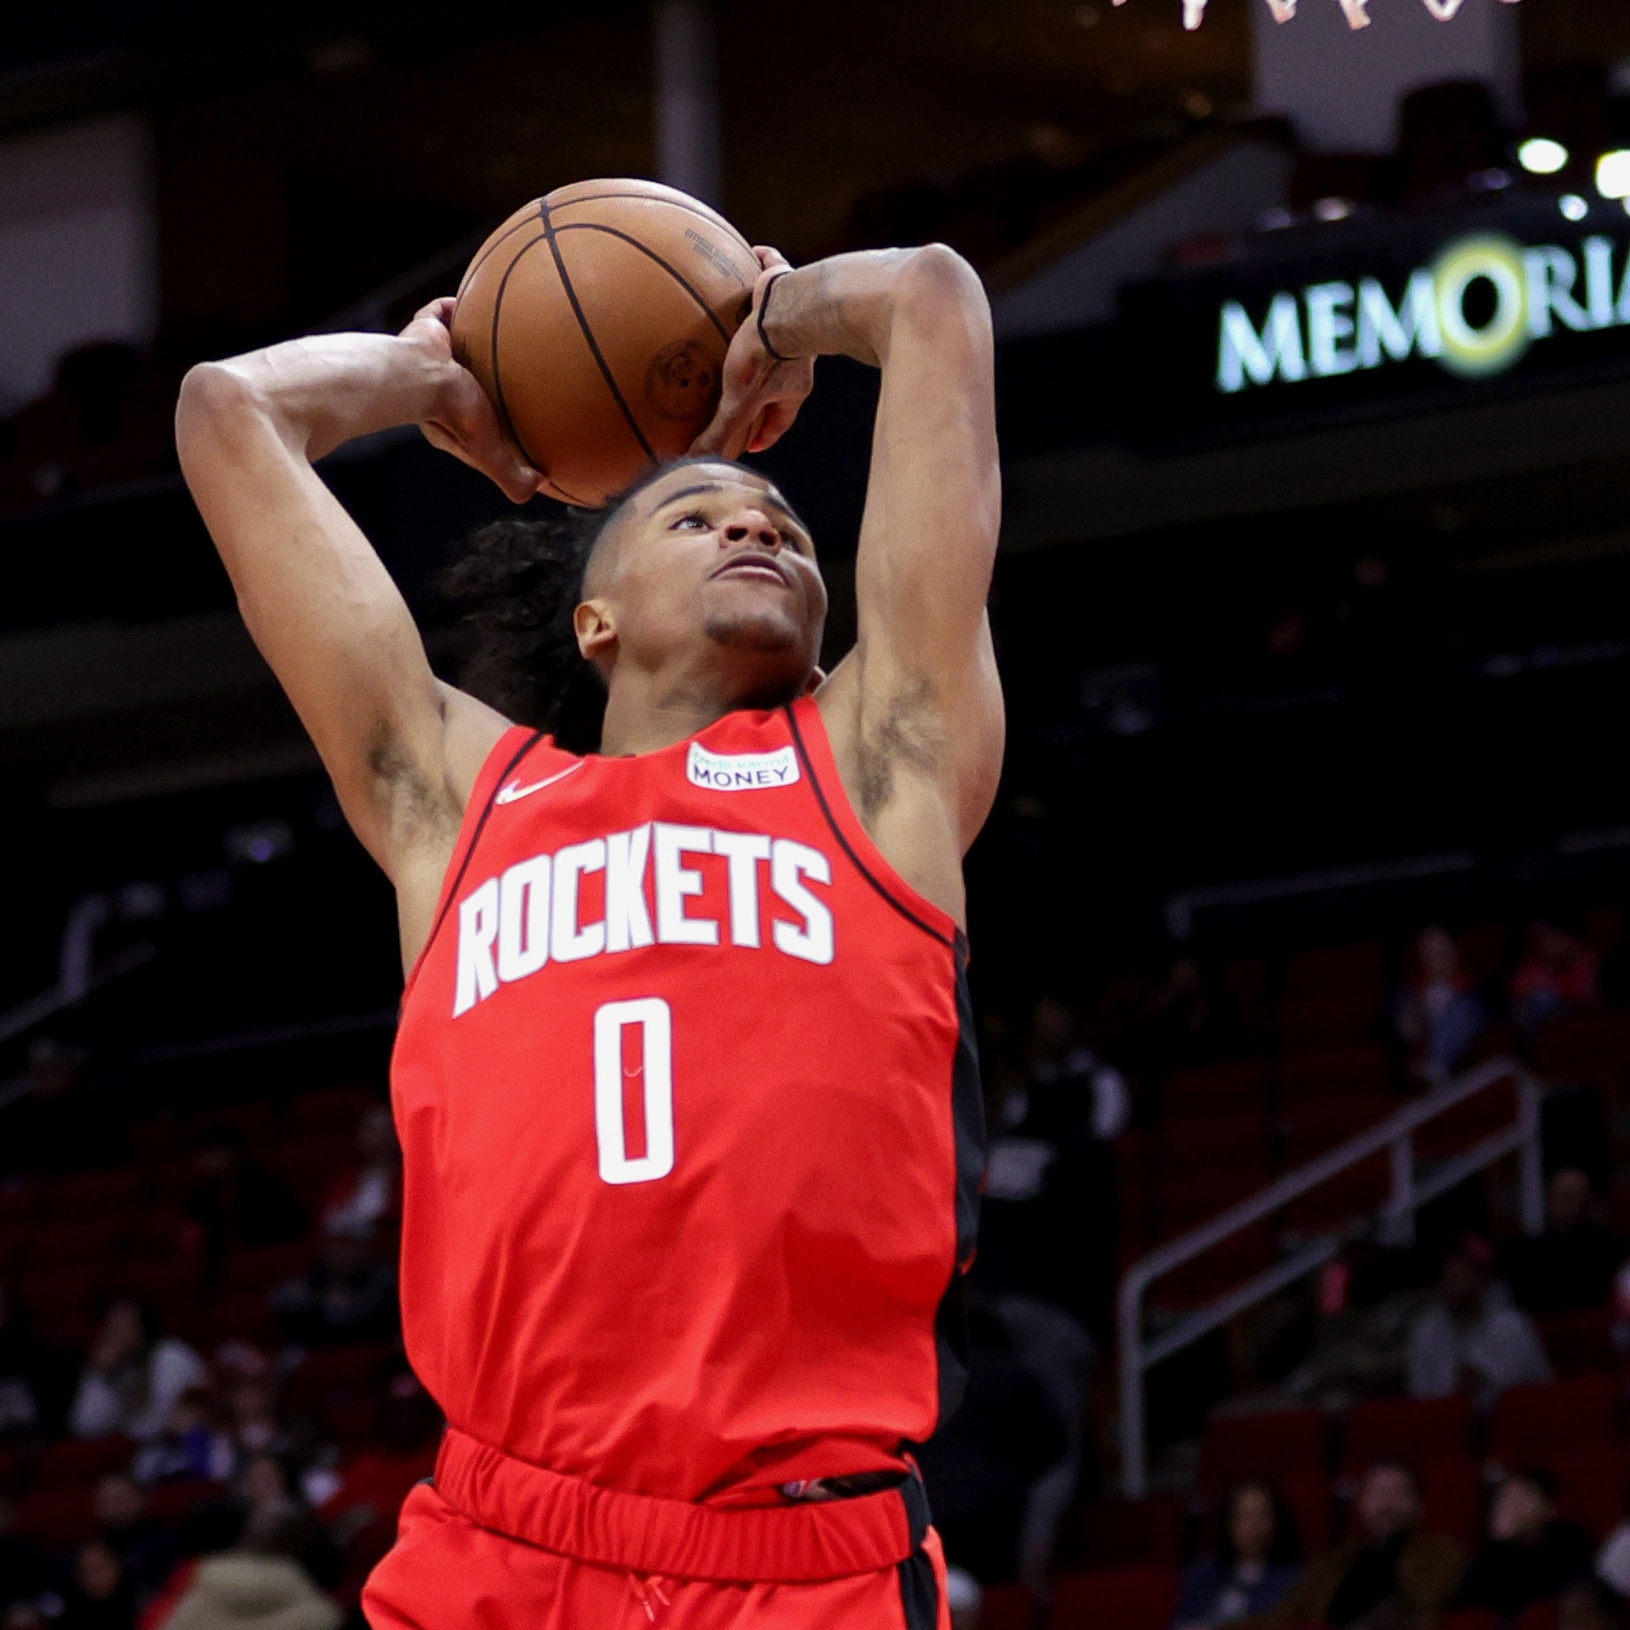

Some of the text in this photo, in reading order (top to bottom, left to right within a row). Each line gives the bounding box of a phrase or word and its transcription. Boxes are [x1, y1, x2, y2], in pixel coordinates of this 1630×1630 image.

[693, 763, 789, 787] MONEY
[453, 821, 834, 1020] ROCKETS
[594, 997, 674, 1185] 0
